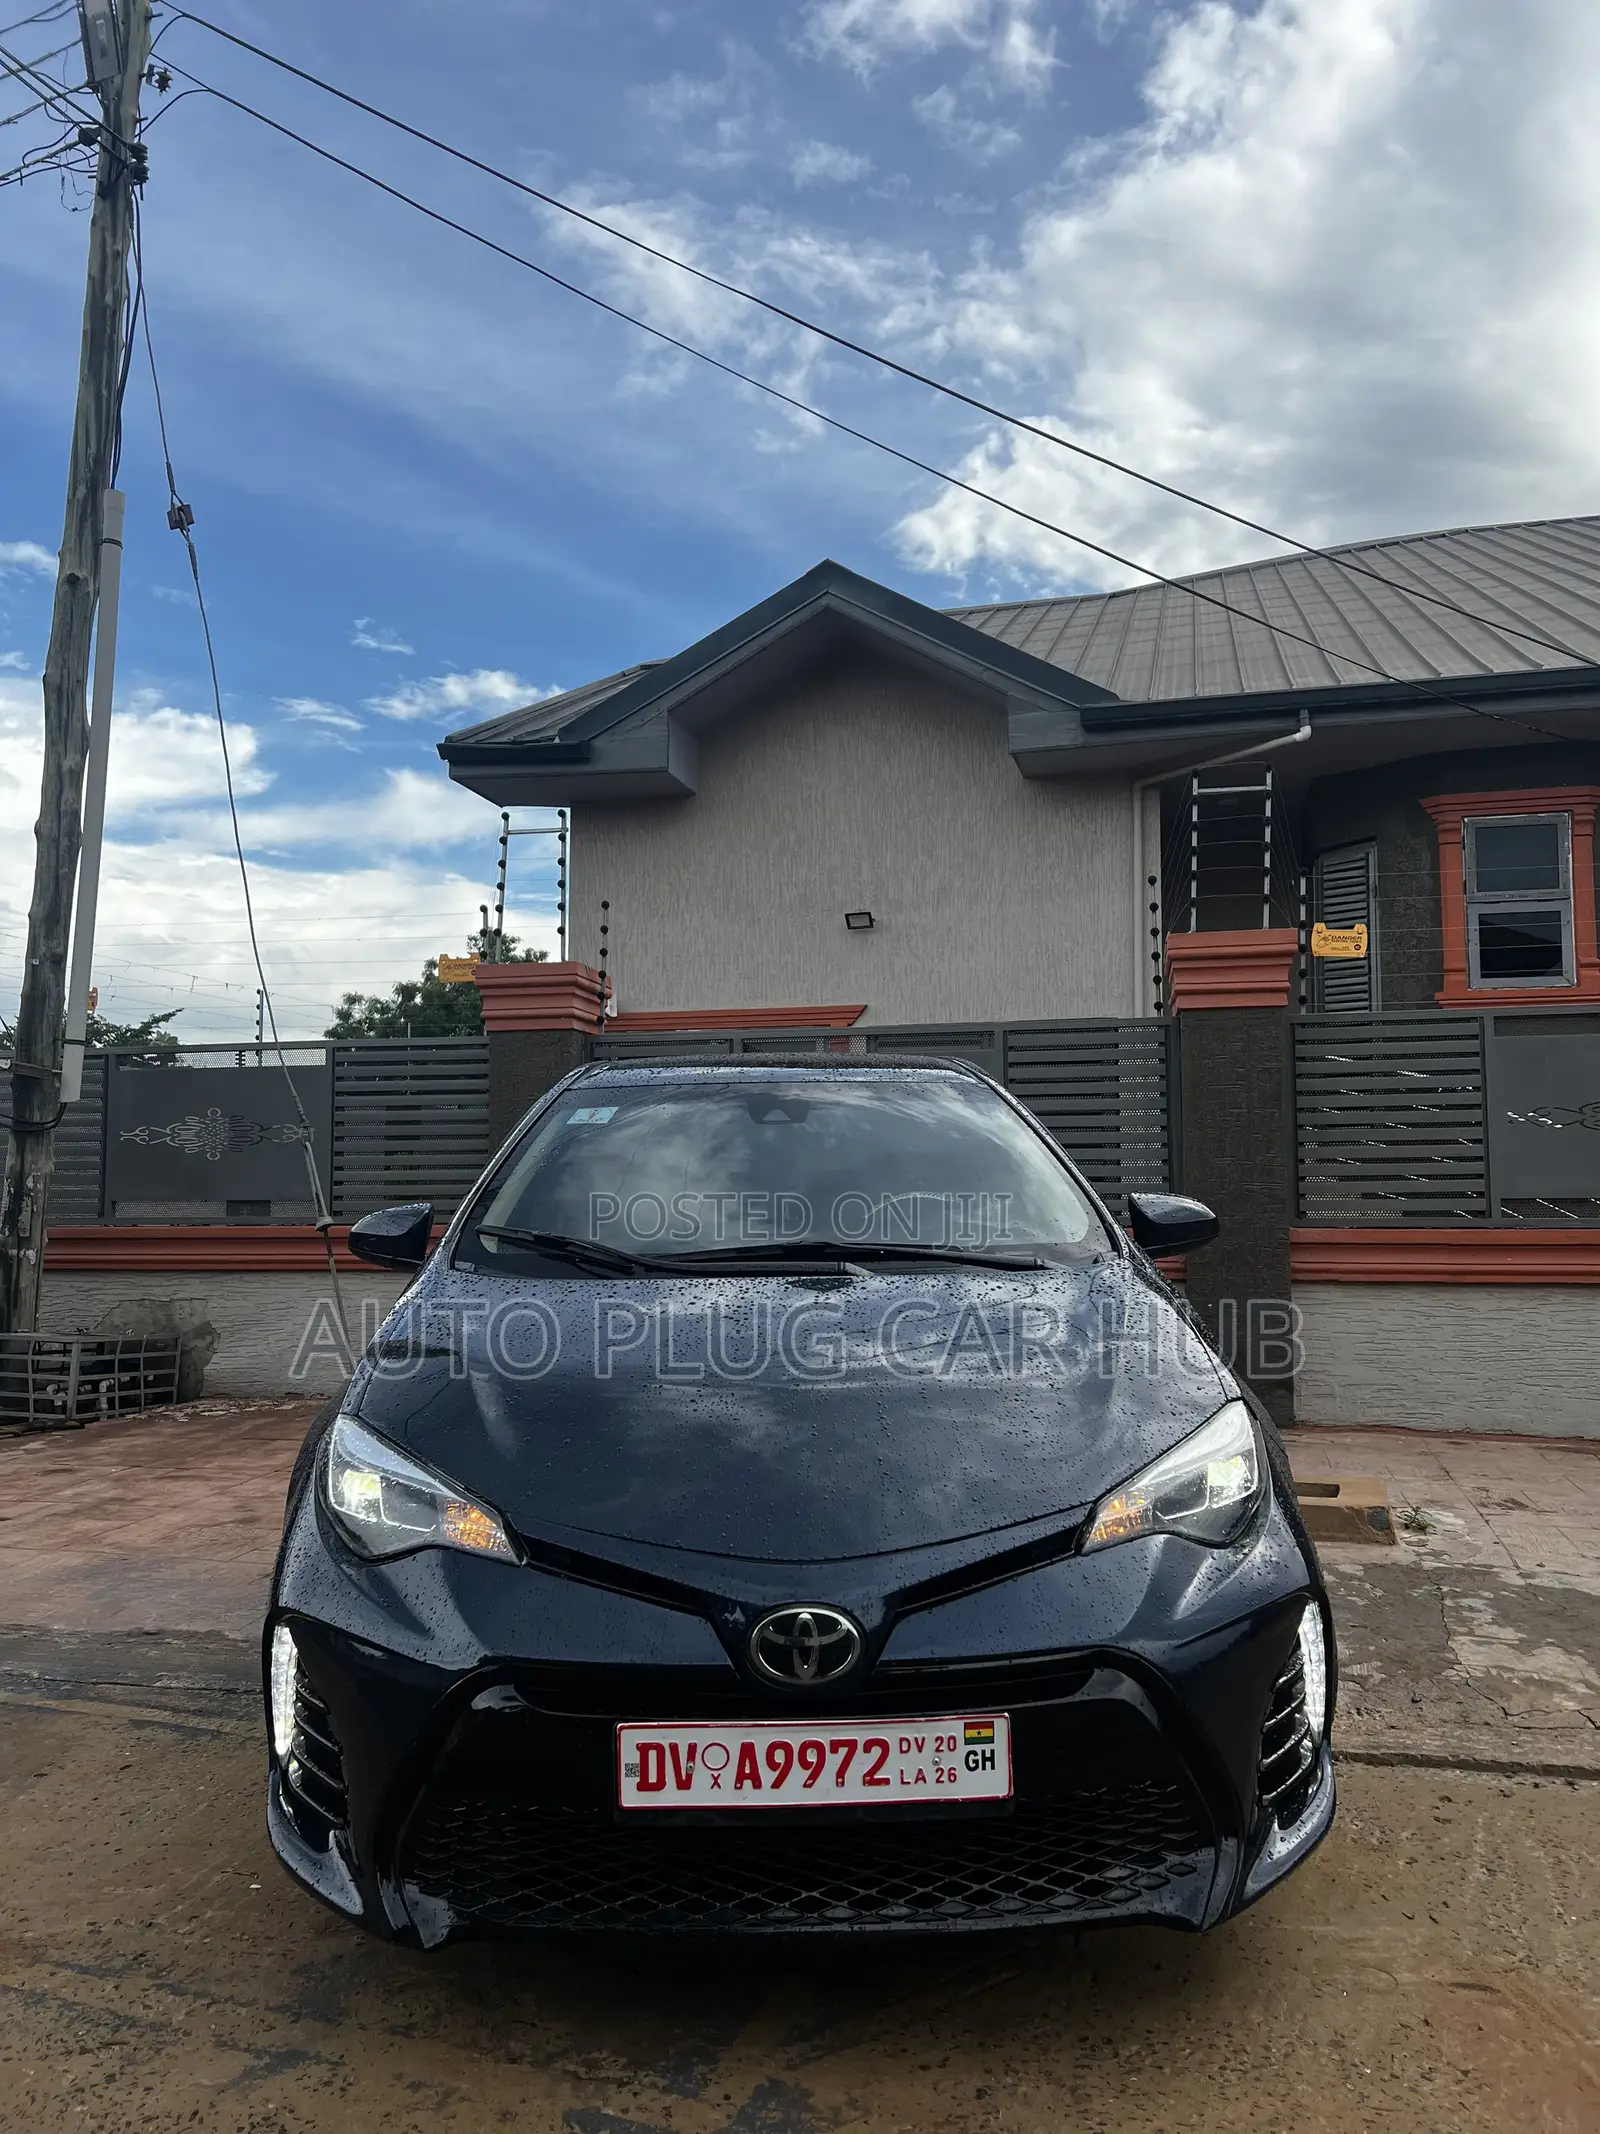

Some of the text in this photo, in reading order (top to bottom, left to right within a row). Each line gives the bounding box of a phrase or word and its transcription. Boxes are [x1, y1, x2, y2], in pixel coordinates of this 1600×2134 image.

[899, 1734, 958, 1754] DV 20
[636, 1737, 891, 1792] DV A9972
[964, 1749, 996, 1772] GH
[899, 1766, 959, 1786] LA 26
